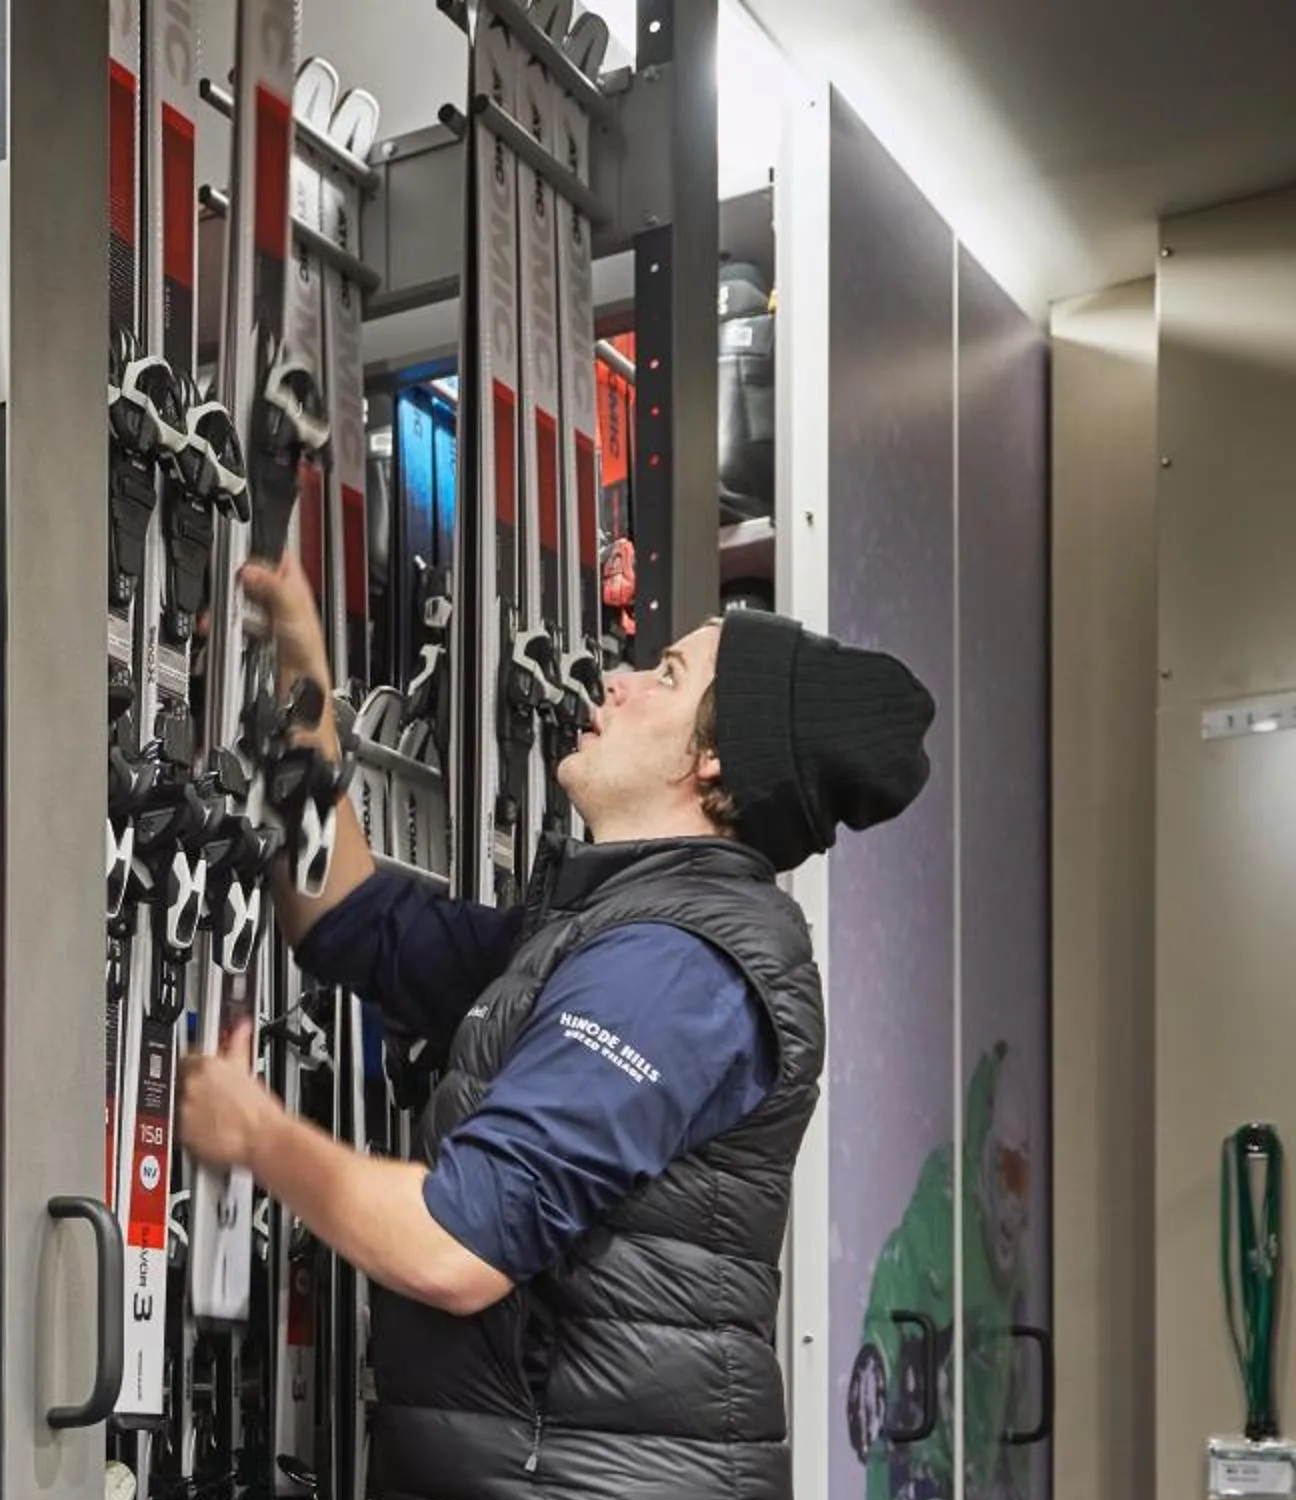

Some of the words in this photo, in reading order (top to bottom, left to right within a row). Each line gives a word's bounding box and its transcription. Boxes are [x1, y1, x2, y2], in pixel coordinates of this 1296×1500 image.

[560, 1012, 621, 1049] HINODE
[620, 1045, 662, 1083] HILLS
[140, 1122, 163, 1145] 158
[133, 1291, 153, 1322] 3
